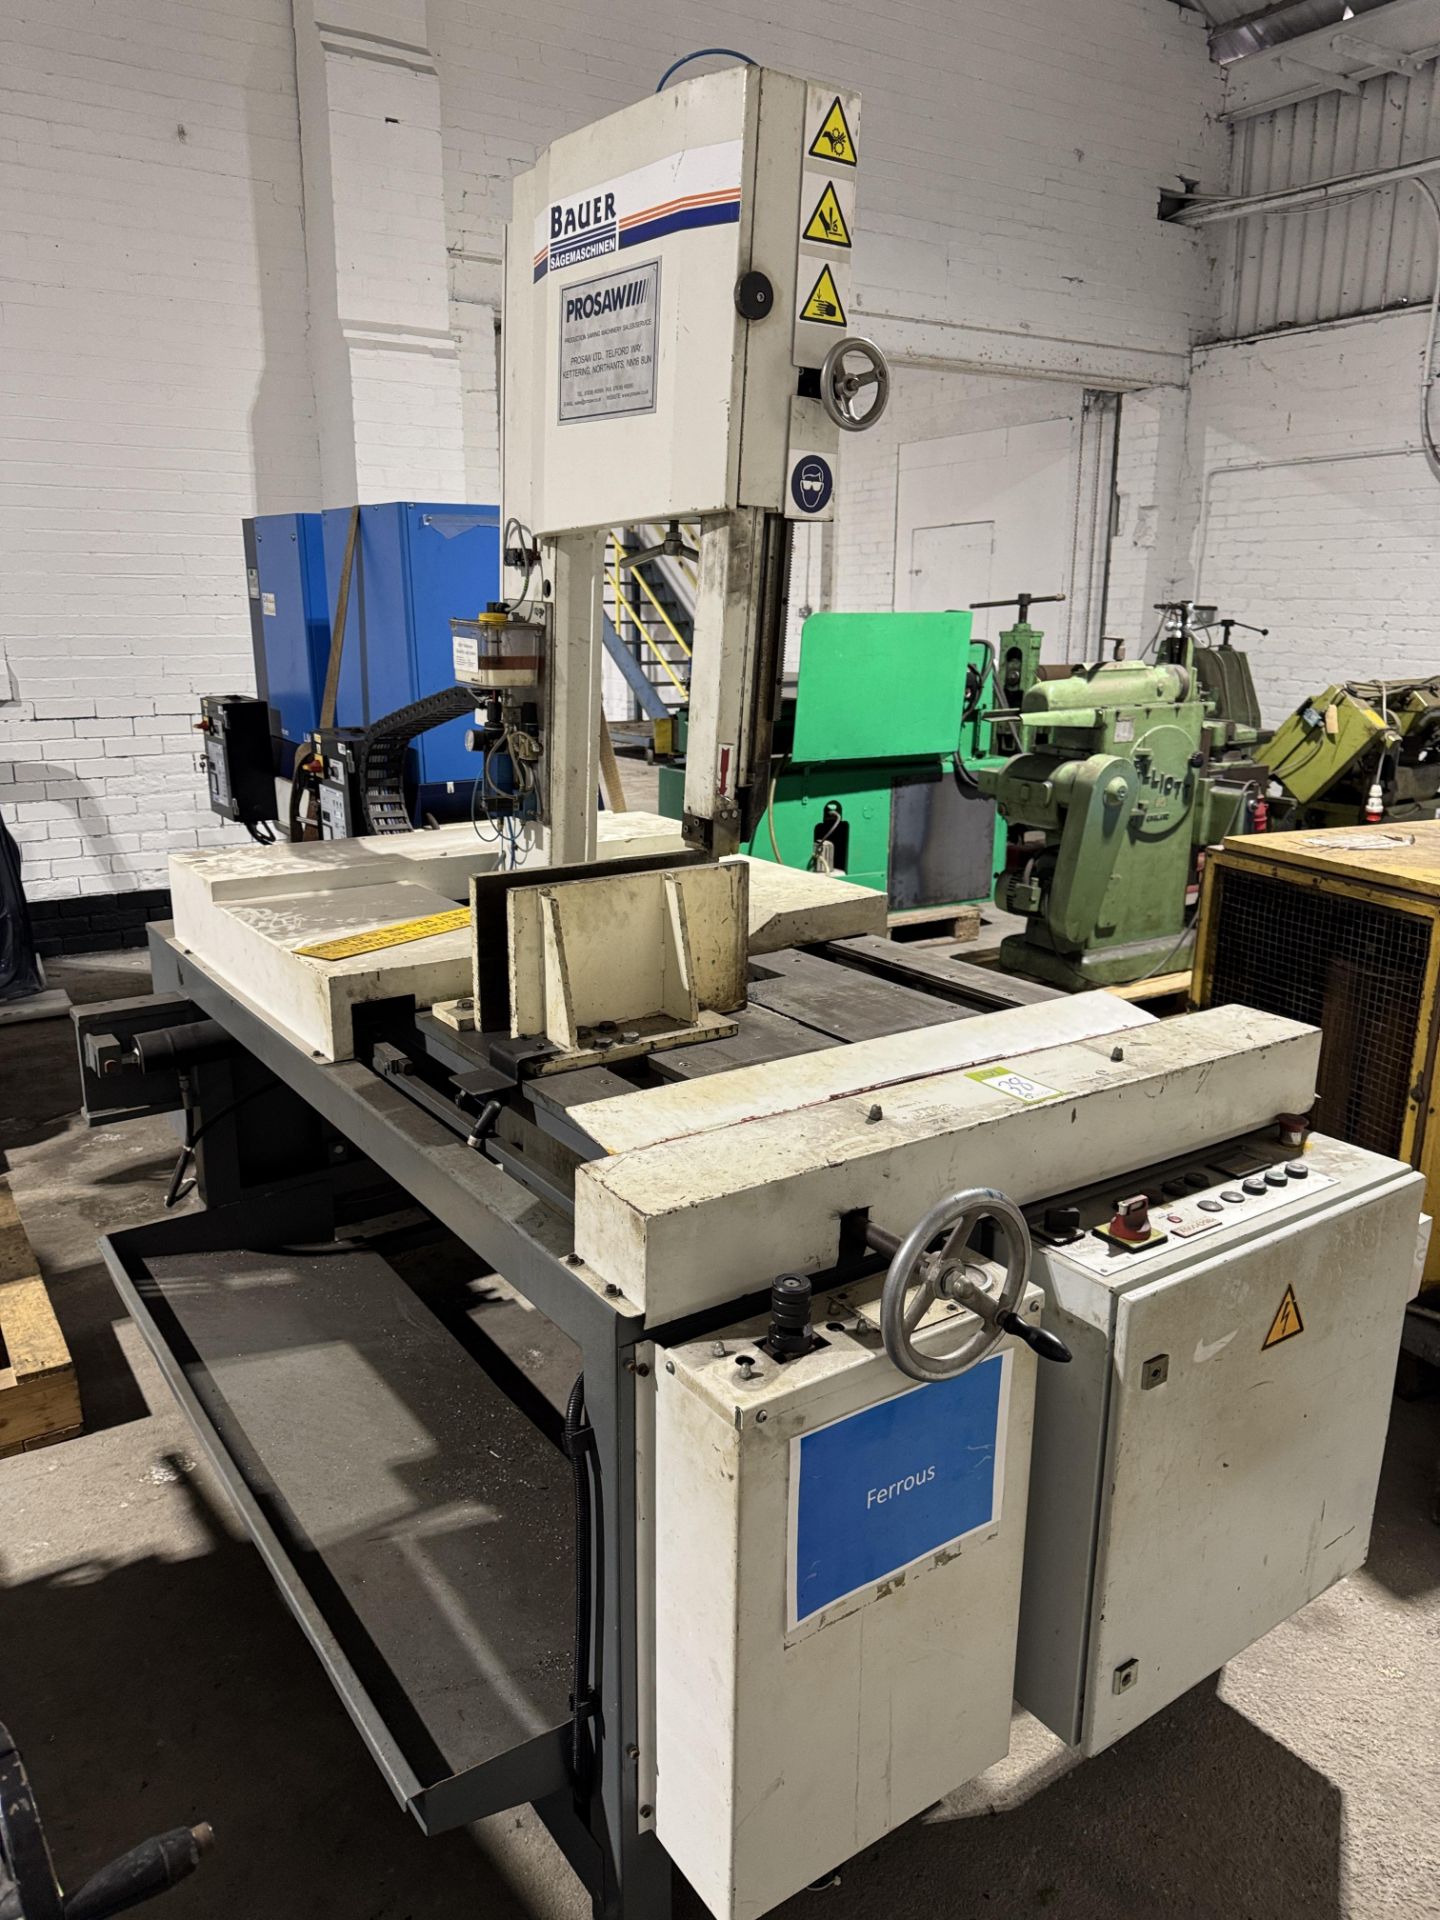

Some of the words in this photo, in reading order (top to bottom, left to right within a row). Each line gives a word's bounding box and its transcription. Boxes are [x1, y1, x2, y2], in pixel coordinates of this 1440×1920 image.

[550, 192, 616, 239] BAUER
[550, 237, 616, 269] SÄGEMASCHINEN
[605, 346, 630, 358] TELFORD
[998, 1076, 1034, 1096] 38
[866, 1465, 936, 1510] Ferrous
